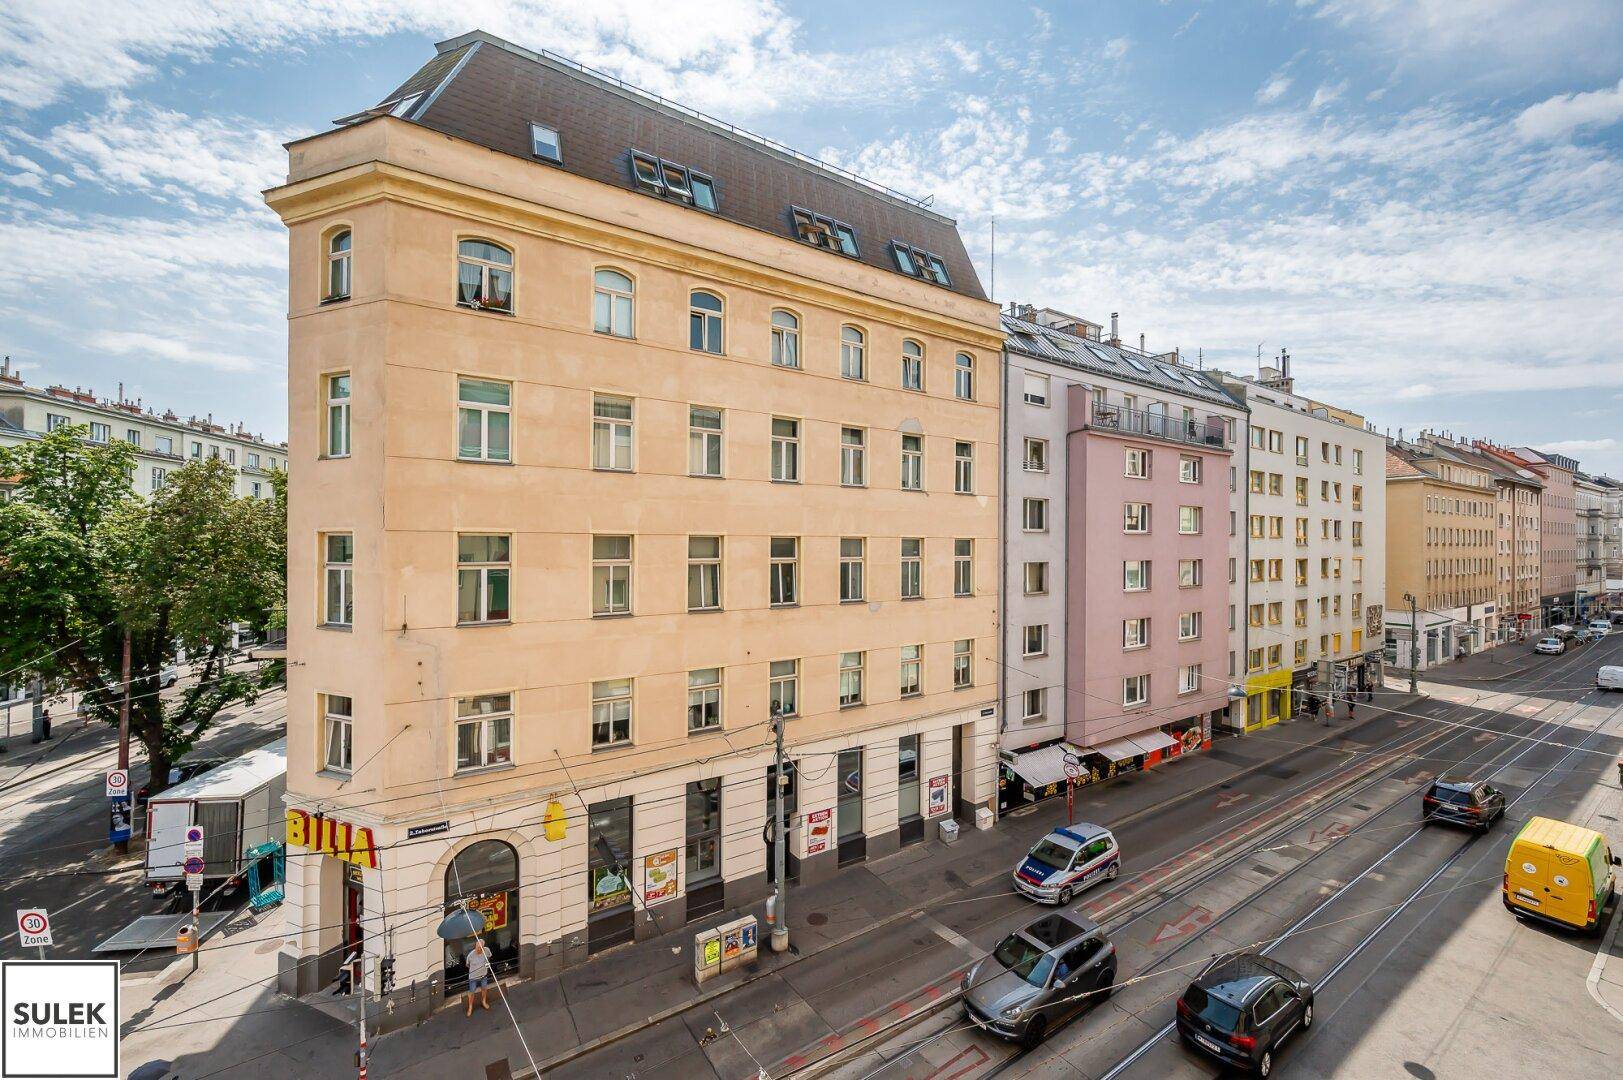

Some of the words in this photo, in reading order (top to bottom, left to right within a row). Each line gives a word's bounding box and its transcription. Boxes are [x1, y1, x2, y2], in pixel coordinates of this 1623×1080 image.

[112, 776, 122, 784] 30
[286, 808, 377, 869] BILLA
[1025, 865, 1045, 876] POLIZEI
[26, 918, 41, 929] 30
[24, 935, 49, 945] Zone
